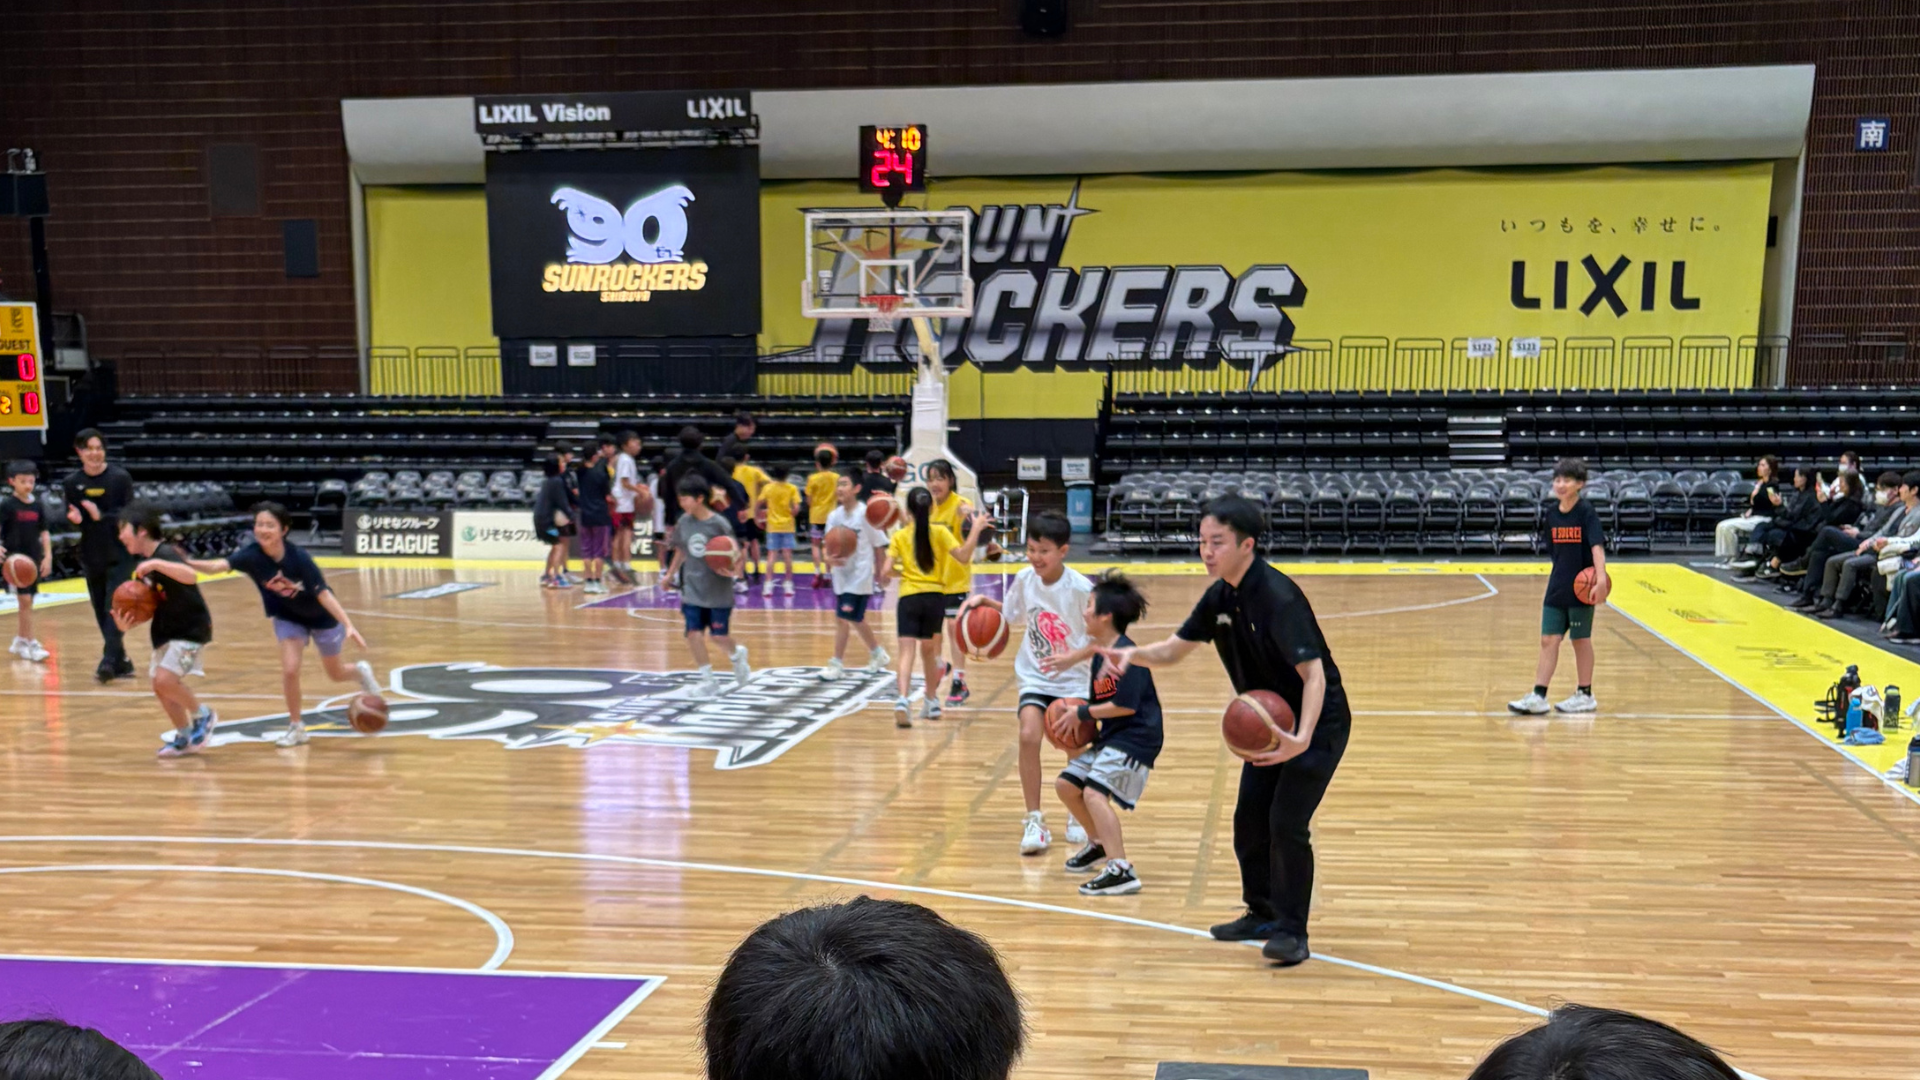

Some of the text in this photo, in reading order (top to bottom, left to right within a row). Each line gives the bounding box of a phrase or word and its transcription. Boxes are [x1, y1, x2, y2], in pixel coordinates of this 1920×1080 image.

[479, 103, 611, 124] LIXIL Vision
[687, 97, 747, 120] LIXIL
[876, 127, 921, 151] 4:10
[1860, 120, 1886, 149] 南
[871, 150, 912, 188] 24
[550, 185, 695, 264] 90
[542, 262, 709, 293] SUNROCKERS
[1510, 254, 1701, 318] LIXIL
[18, 353, 36, 382] 0
[24, 391, 39, 415] 0
